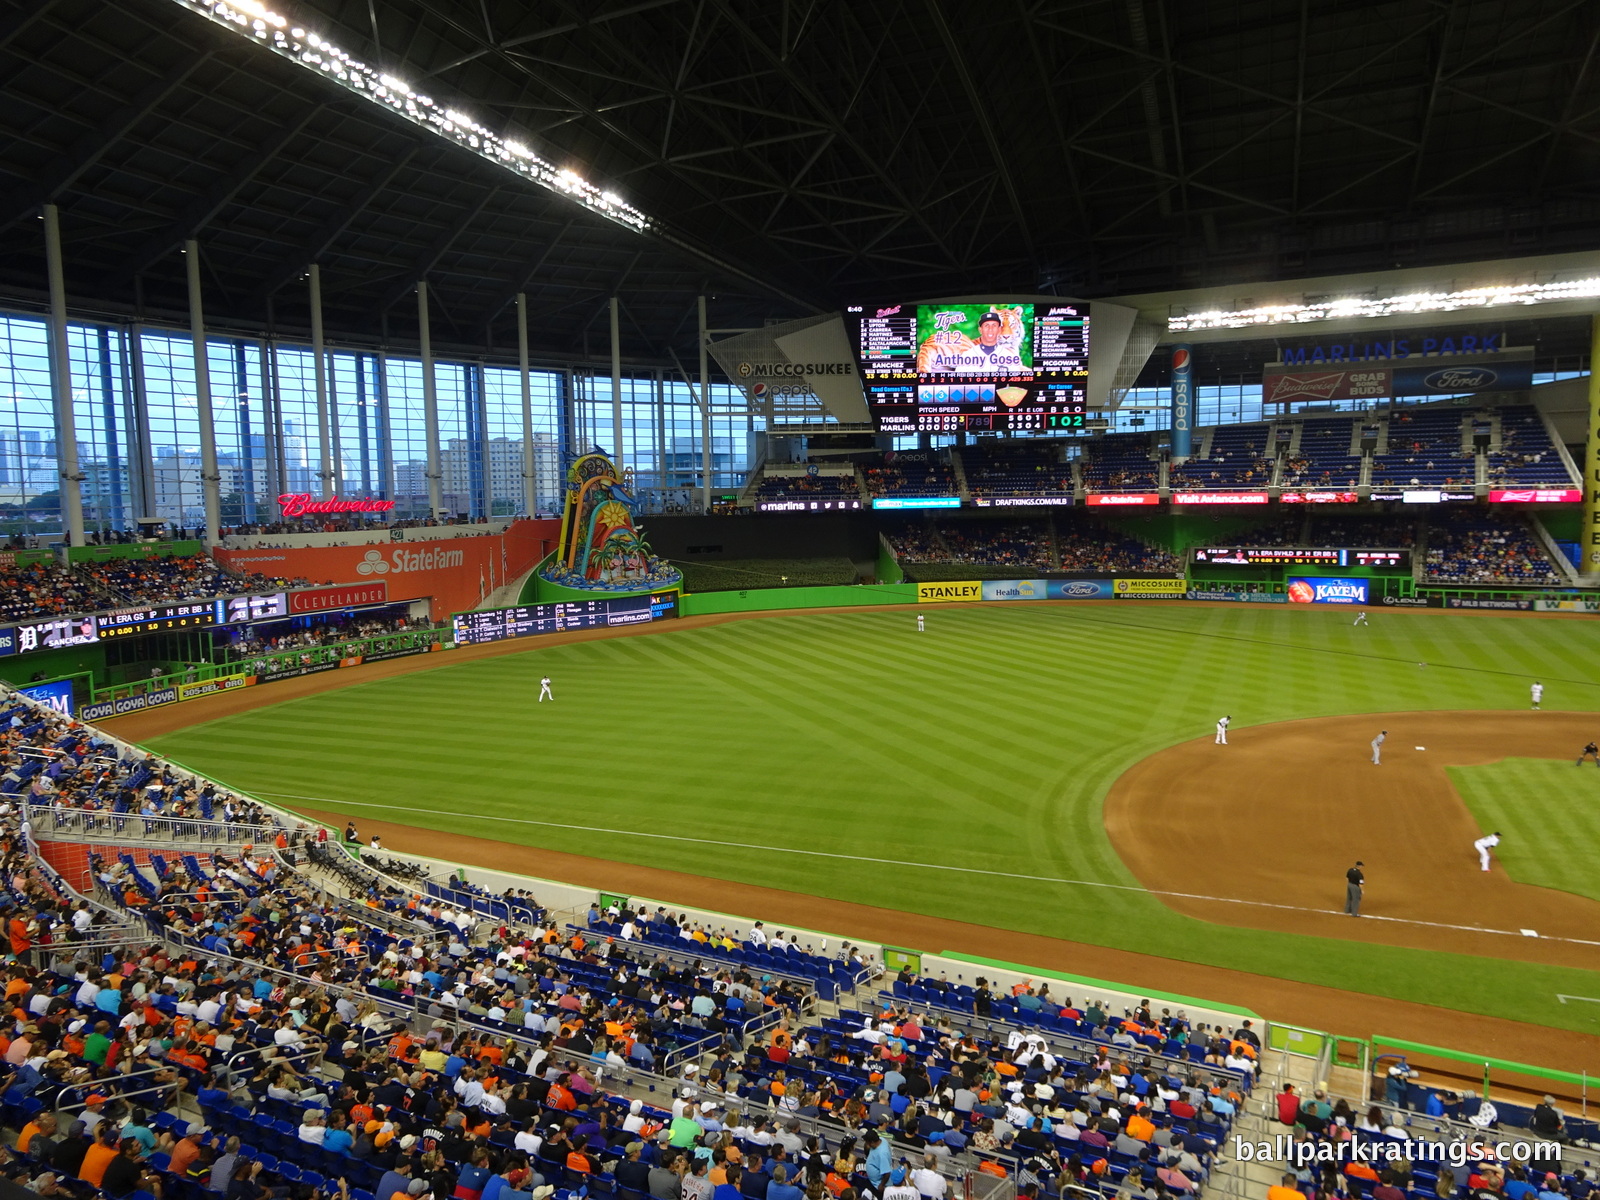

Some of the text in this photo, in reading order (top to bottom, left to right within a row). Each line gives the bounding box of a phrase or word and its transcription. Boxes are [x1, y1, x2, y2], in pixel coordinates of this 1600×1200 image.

[934, 311, 967, 331] Tigers
[935, 331, 961, 345] #12
[1283, 334, 1499, 366] MARLINS PARK
[935, 353, 1020, 367] Anthony Gose
[754, 363, 851, 376] MICCOSUKEE
[1350, 372, 1386, 382] GRAB
[1437, 371, 1484, 388] Ford
[770, 383, 812, 398] pepsi
[1271, 380, 1341, 394] Budweiser
[1350, 386, 1385, 396] BUDS
[1174, 378, 1188, 431] pepsi
[1050, 416, 1082, 426] 1 0 2
[900, 453, 928, 462] pepsi
[278, 494, 396, 517] Budweiser
[996, 498, 1067, 506] DRAFTKINGS.COM/MLB
[1177, 494, 1264, 503] Visit Avianca.com
[391, 550, 464, 573] StateFarm
[921, 586, 979, 598] STANLEY
[996, 588, 1034, 597] HealthSun
[1068, 584, 1096, 596] Ford
[1316, 585, 1365, 602] KAYEM
[294, 590, 382, 610] CLEVELANDER
[117, 615, 132, 623] ERA
[610, 613, 650, 623] marlins.com
[48, 636, 84, 647] SANCHEZ
[184, 684, 219, 698] 305-DEL
[225, 679, 243, 688] ORO
[116, 698, 145, 712] GOYA
[148, 690, 175, 706] GOYA
[83, 705, 113, 720] GOYA
[837, 952, 845, 960] 25
[1030, 1044, 1036, 1056] 7
[424, 1138, 436, 1152] 16
